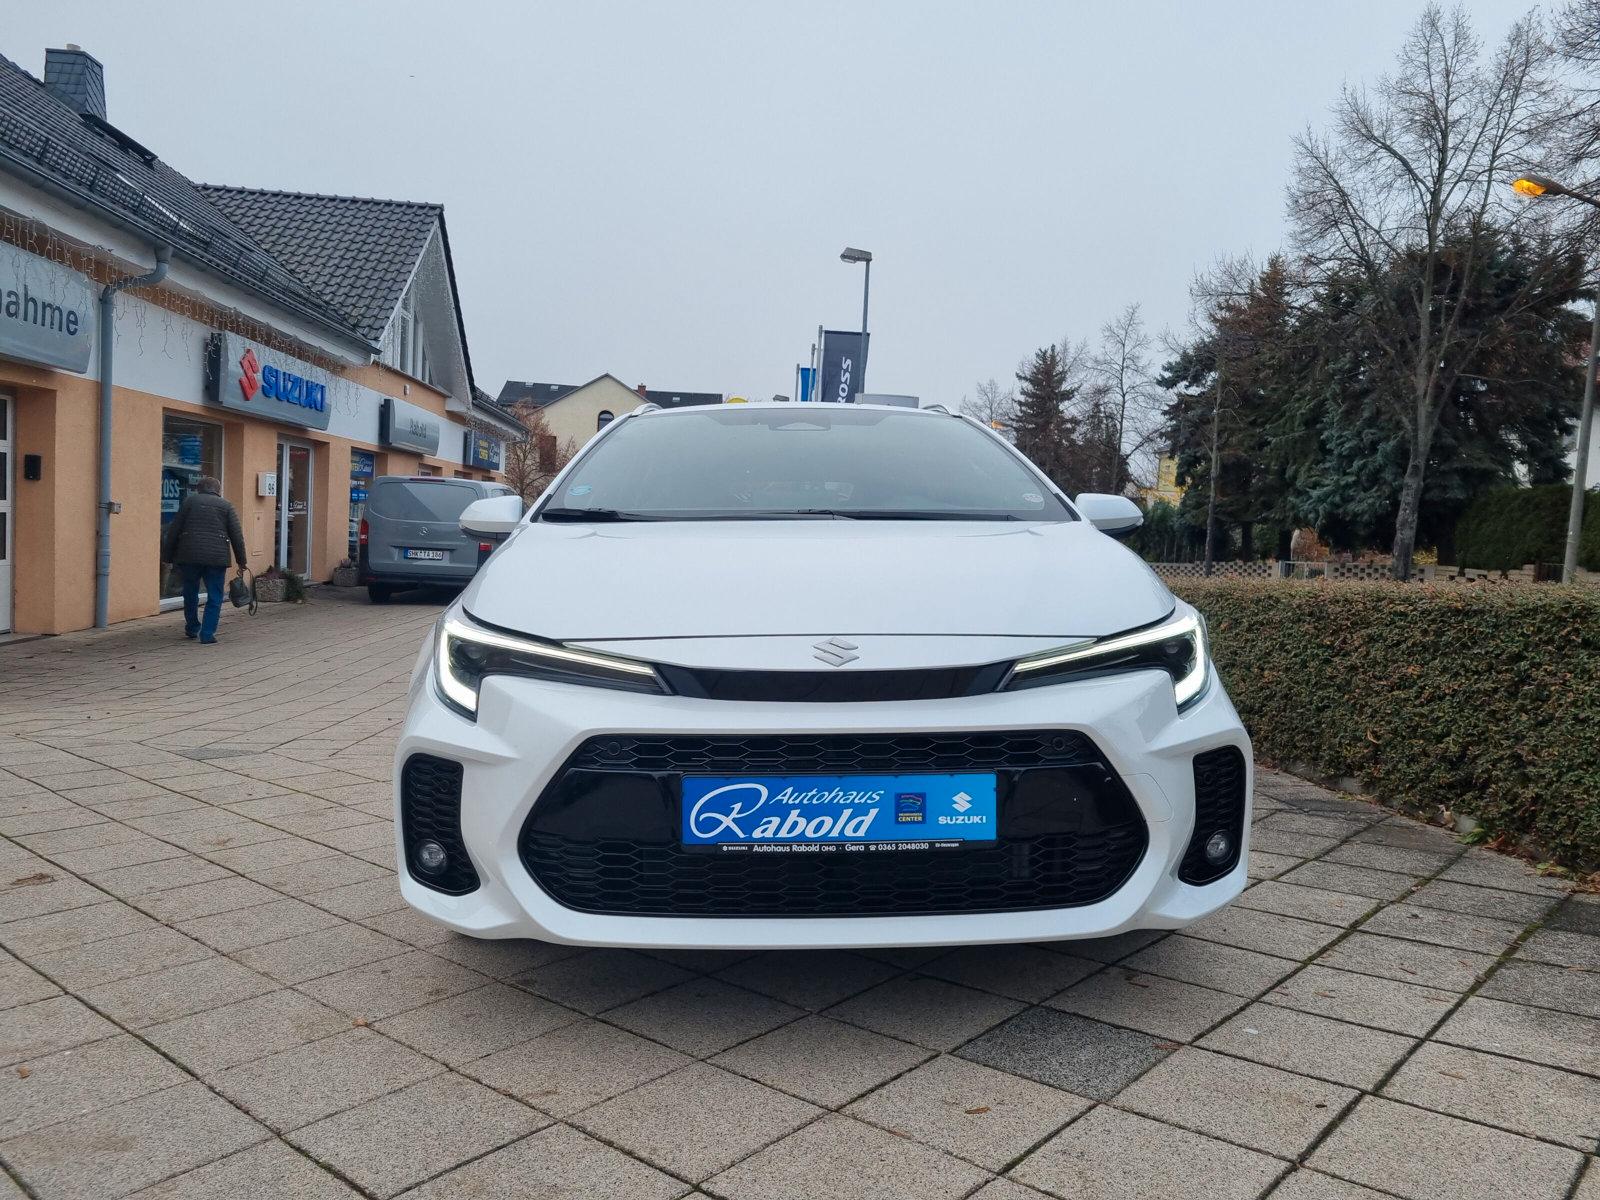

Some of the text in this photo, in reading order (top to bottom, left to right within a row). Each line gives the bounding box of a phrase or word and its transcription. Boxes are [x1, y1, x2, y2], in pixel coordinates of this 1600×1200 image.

[0, 284, 79, 336] ahme
[261, 364, 326, 412] SUZUKI
[689, 783, 880, 839] Rabold
[769, 786, 885, 805] Autohaus
[938, 815, 987, 825] SUZUKI
[752, 842, 929, 852] Autohaus Rabold OHG Gera 0365 2048030
